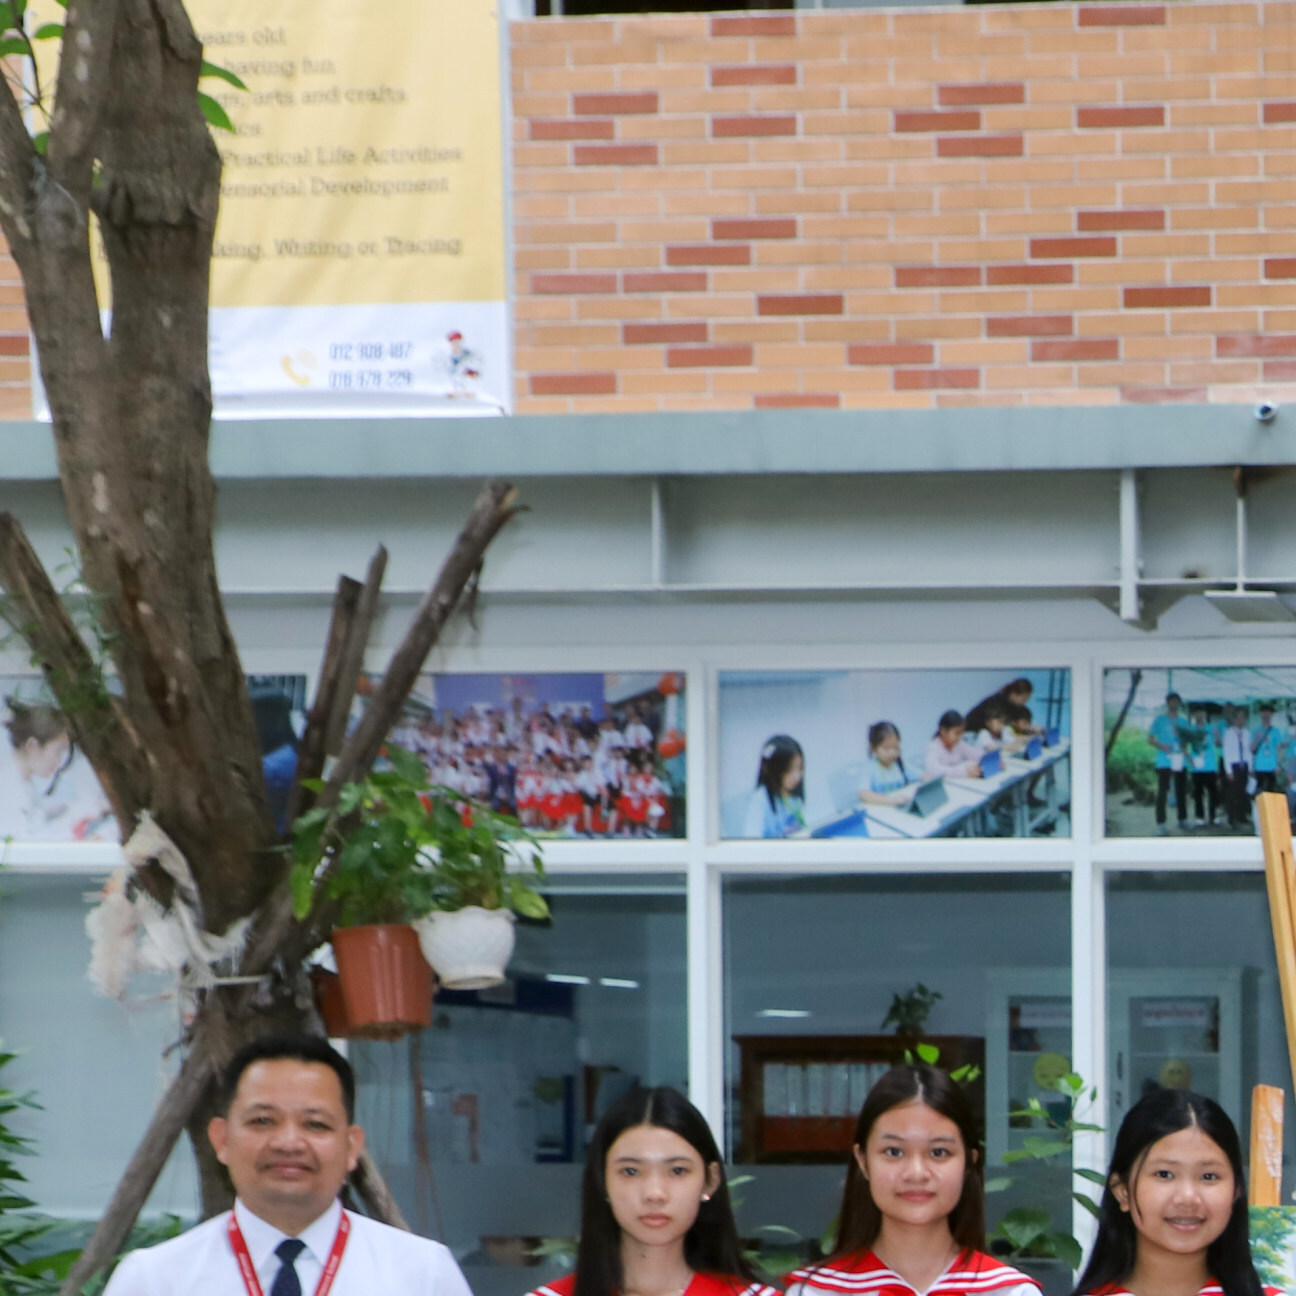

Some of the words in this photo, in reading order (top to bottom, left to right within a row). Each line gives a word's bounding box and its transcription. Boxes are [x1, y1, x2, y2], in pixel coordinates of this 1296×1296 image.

[301, 86, 340, 104] and
[344, 84, 406, 103] crafts
[316, 147, 356, 164] Life
[363, 145, 462, 164] Activities
[220, 179, 304, 197] ensorial
[310, 176, 449, 197] Development
